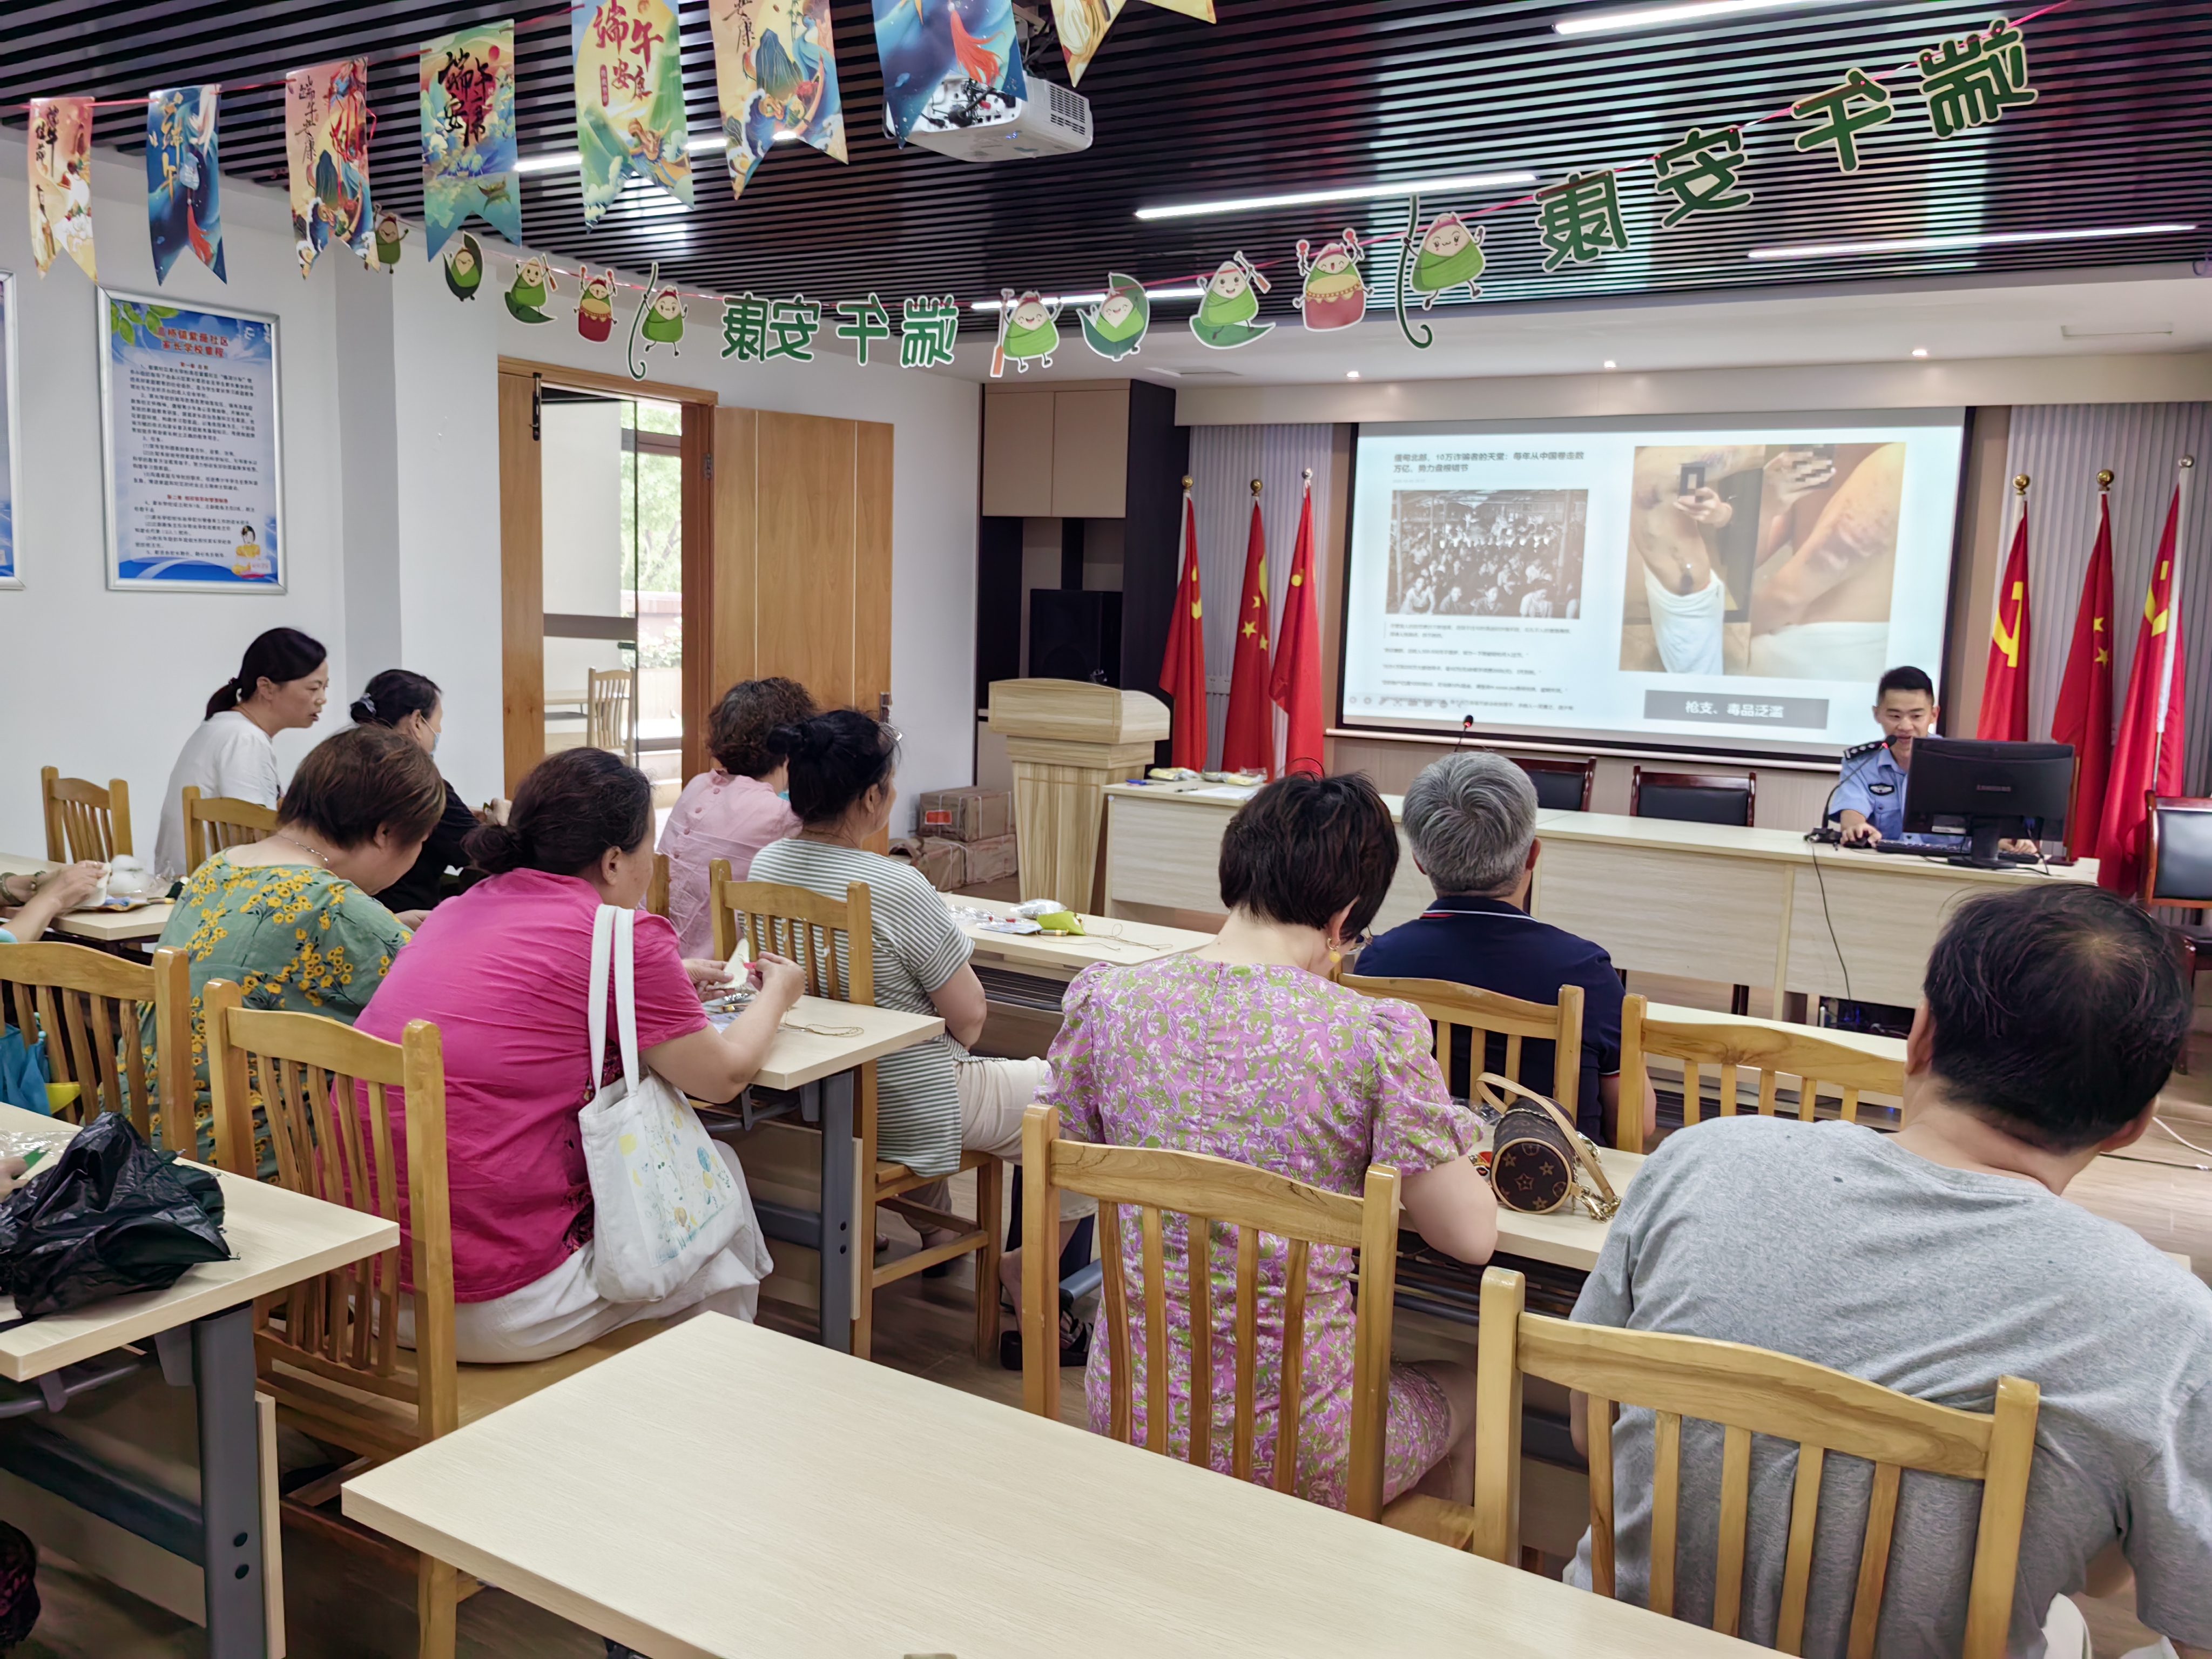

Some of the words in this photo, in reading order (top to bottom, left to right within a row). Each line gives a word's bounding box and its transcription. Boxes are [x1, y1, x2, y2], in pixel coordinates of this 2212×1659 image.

[595, 0, 664, 72] 端午
[612, 59, 652, 103] 安康
[1685, 700, 1784, 718] 枪支、毒品泛滥
